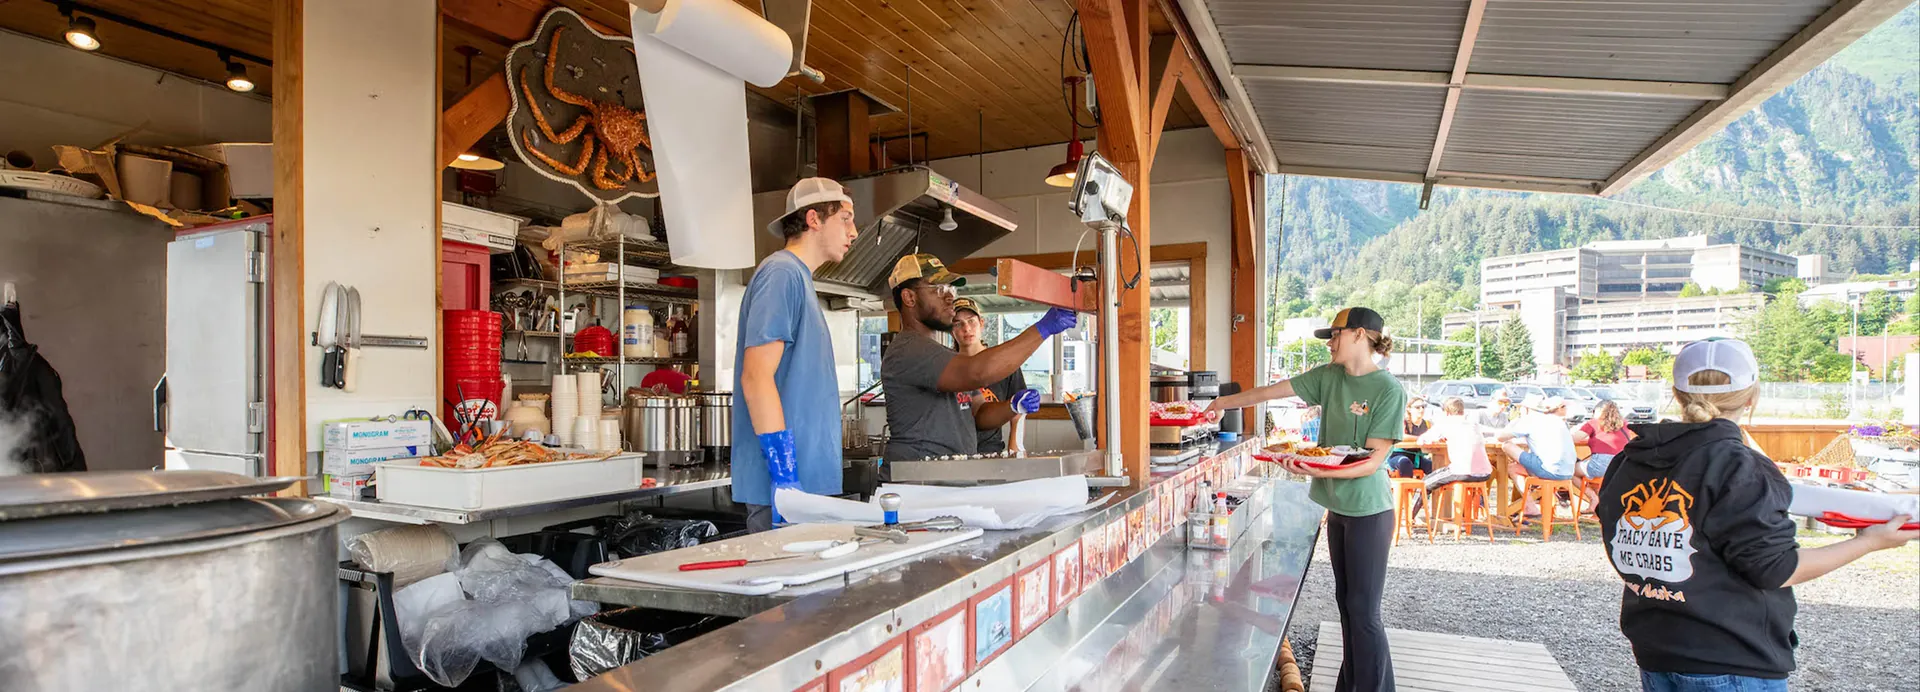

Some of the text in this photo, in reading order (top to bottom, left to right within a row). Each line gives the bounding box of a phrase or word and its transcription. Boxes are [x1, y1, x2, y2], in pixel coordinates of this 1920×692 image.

[352, 430, 389, 438] MONOGRAM
[350, 456, 387, 465] MONOGRAM
[1617, 529, 1684, 550] TRACY GAVE
[1620, 551, 1673, 572] ME CRABS
